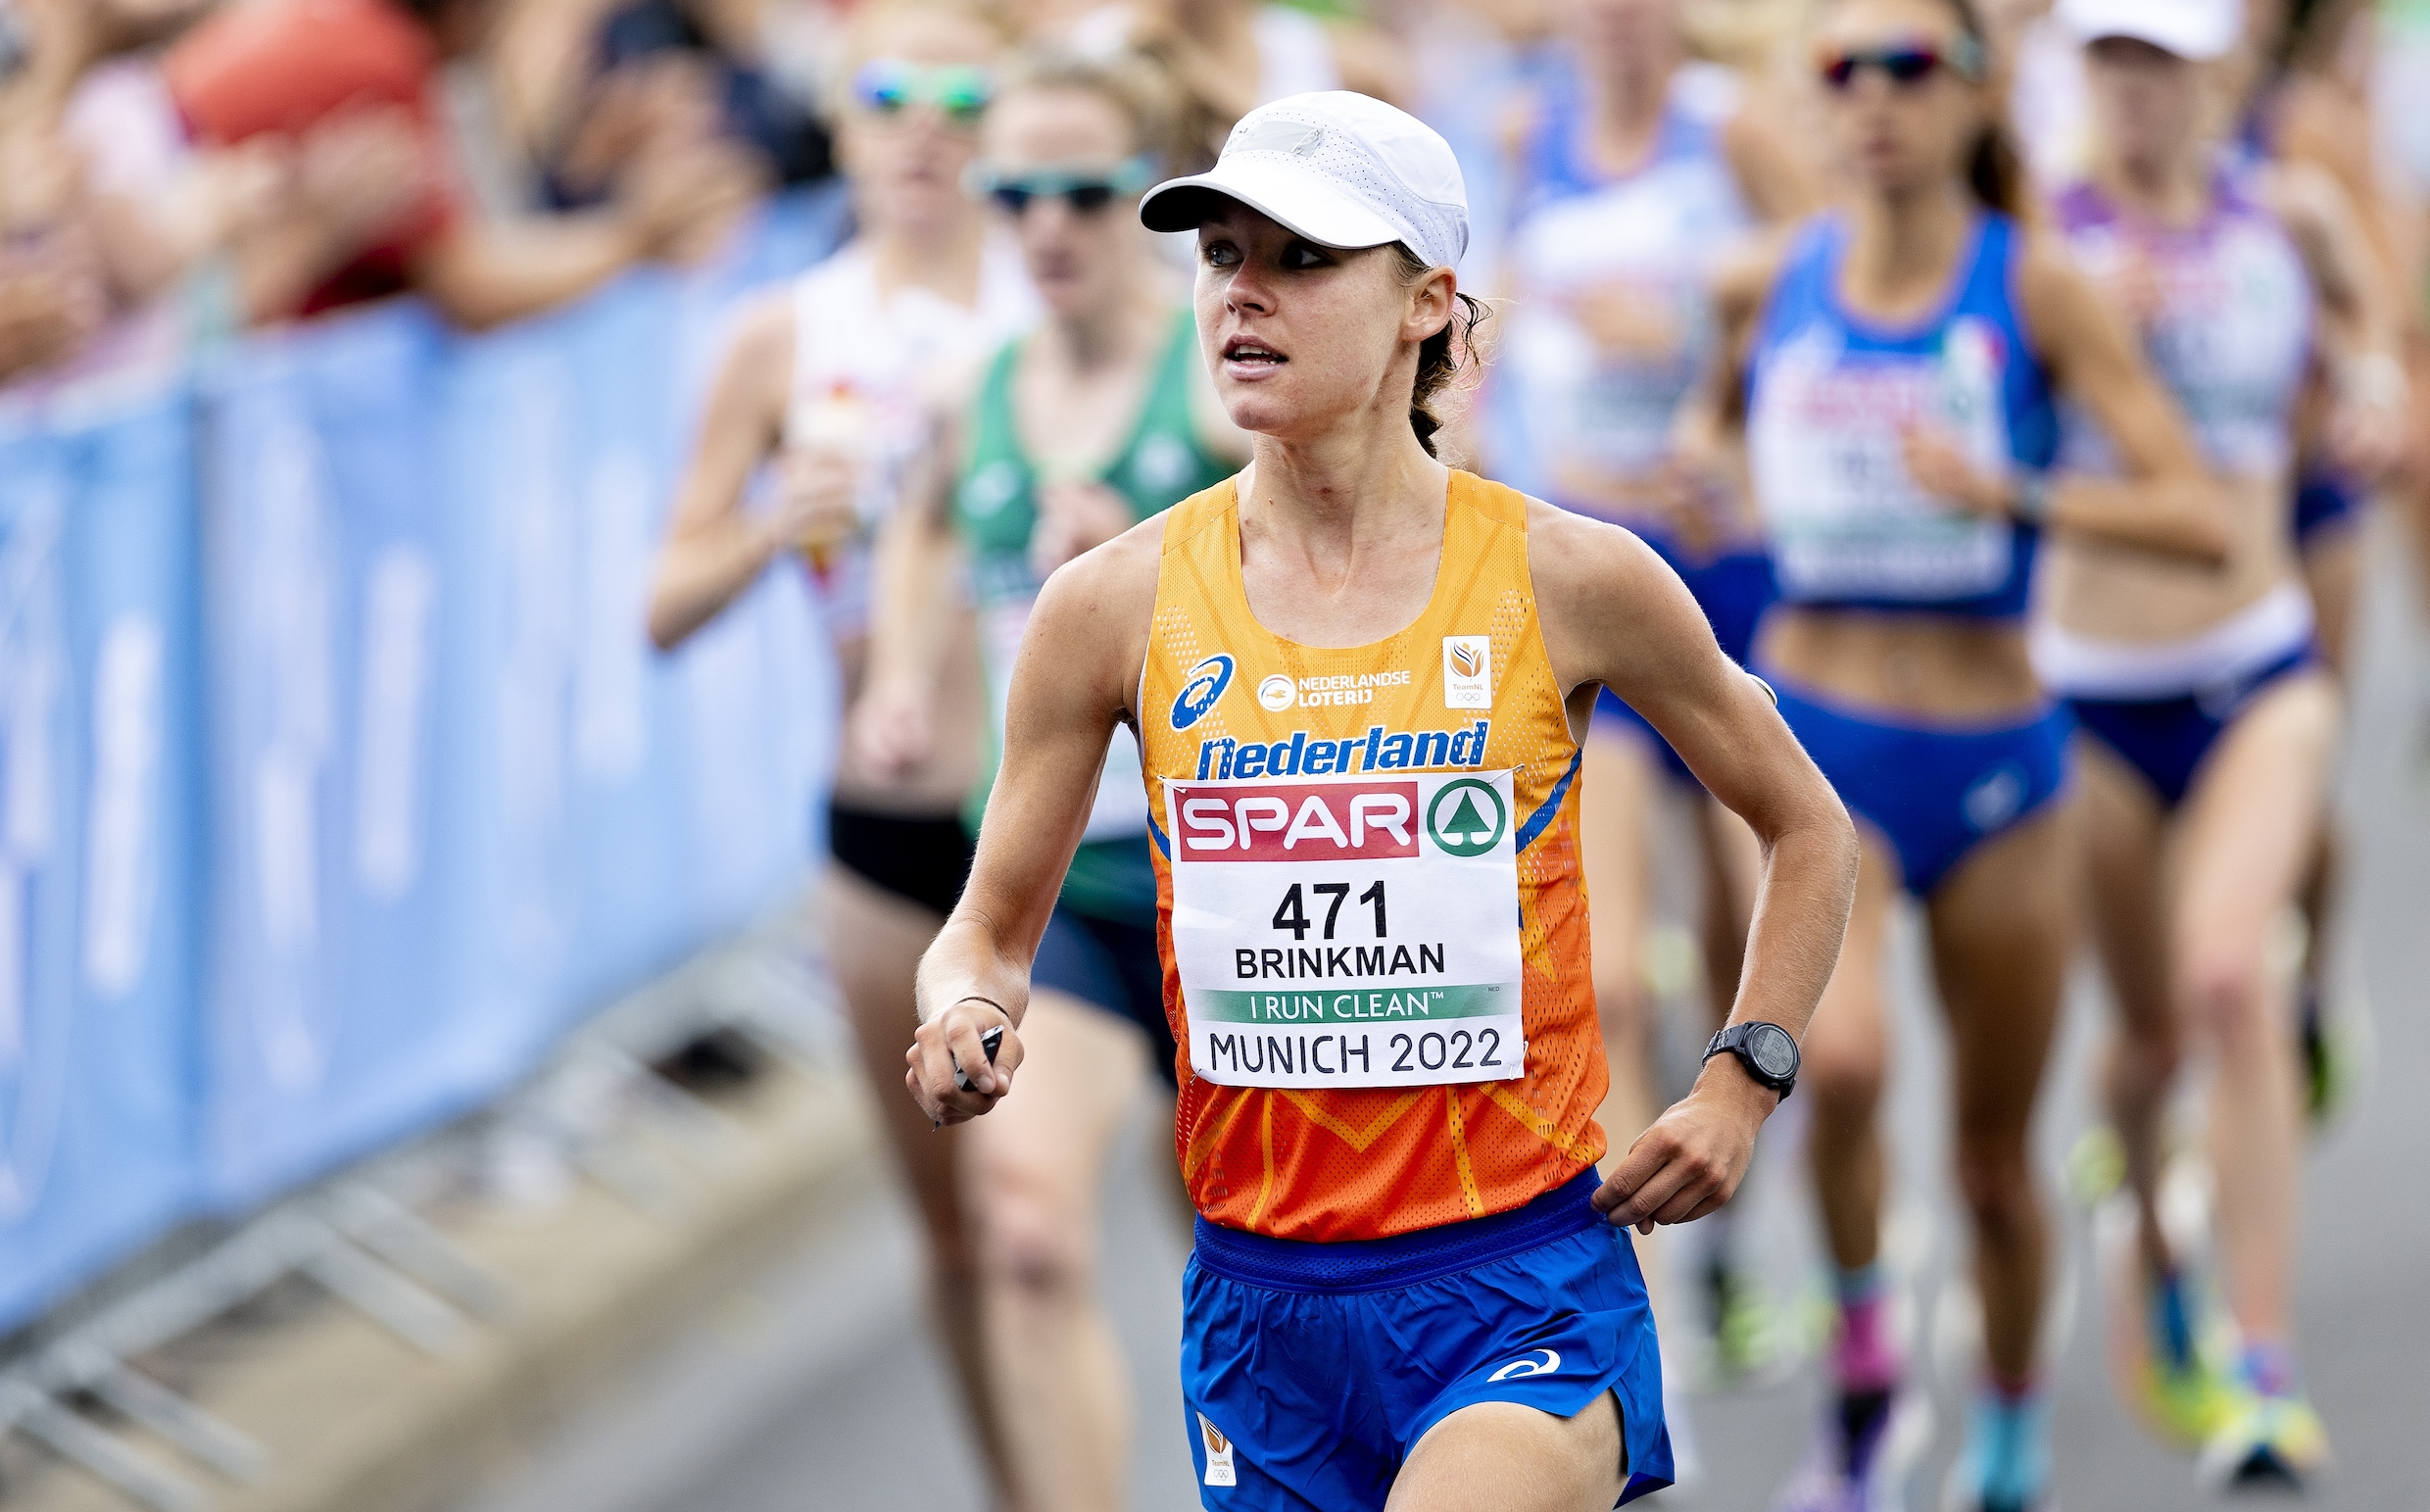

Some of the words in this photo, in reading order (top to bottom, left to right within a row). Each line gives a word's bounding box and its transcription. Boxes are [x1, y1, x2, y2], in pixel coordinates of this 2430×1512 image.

[1298, 670, 1411, 691] NEDERLANDSE
[1298, 689, 1373, 707] LOTERIJ
[1196, 720, 1489, 780] nederland
[1182, 792, 1412, 851] SPAR
[1272, 880, 1388, 941] 471
[1236, 943, 1445, 979] BRINKMAN
[1250, 996, 1257, 1019] I
[1266, 995, 1324, 1019] RUN
[1209, 1033, 1370, 1074] MUNICH
[1389, 1027, 1502, 1072] 2022
